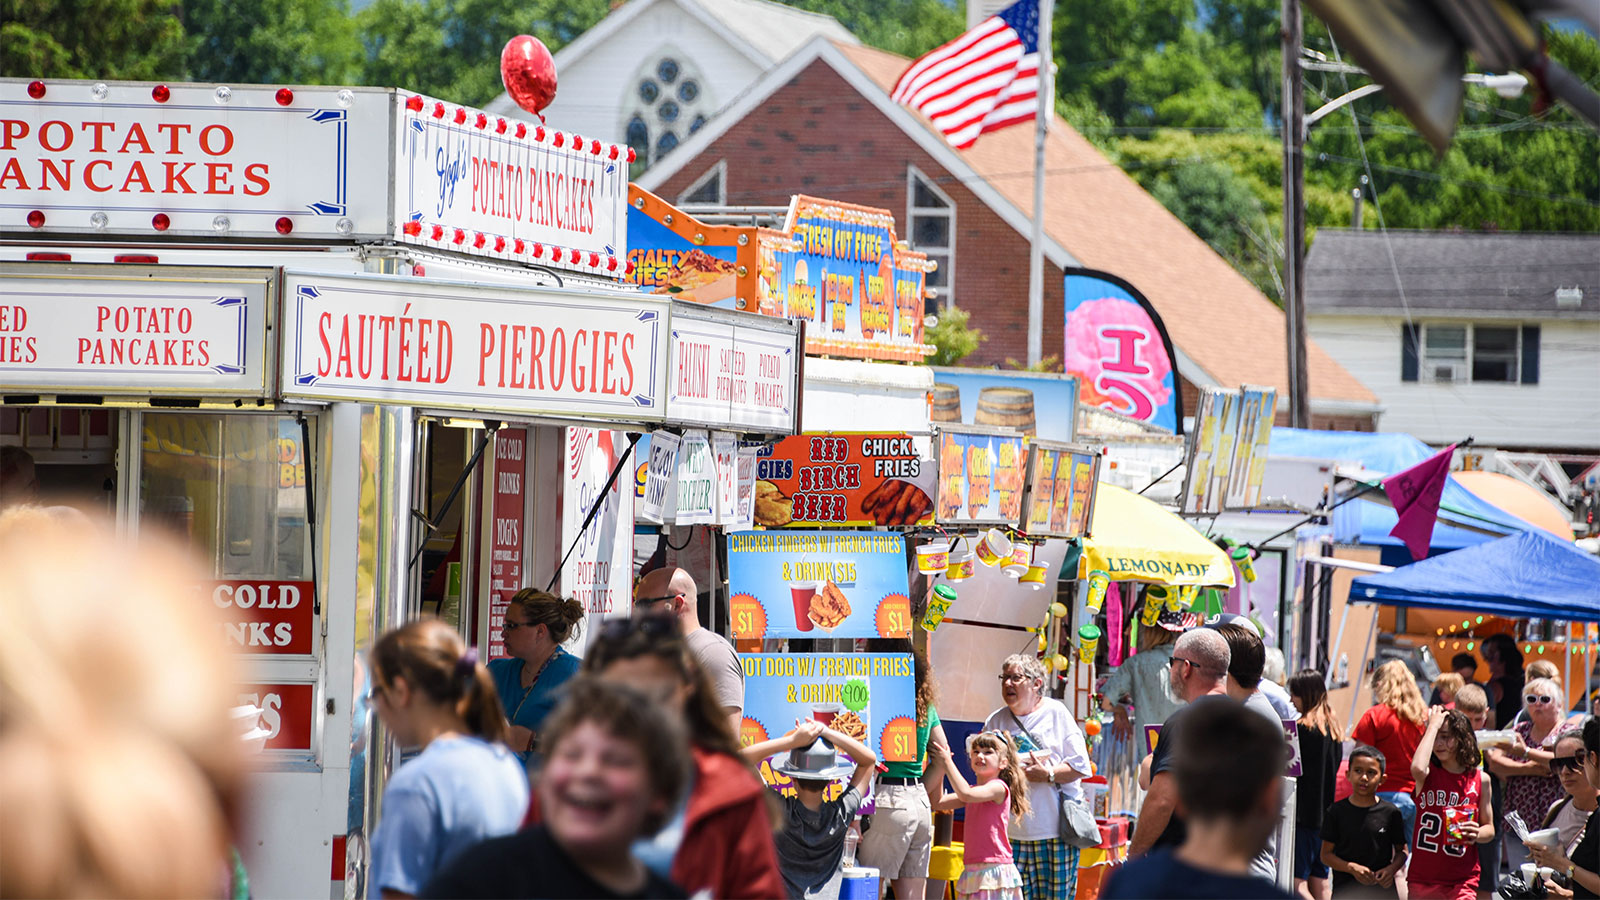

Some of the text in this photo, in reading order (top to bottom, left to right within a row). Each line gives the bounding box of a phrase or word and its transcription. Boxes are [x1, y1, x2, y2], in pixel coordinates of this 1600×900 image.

[0, 119, 235, 156] POTATO
[0, 157, 271, 196] ANCAKES
[471, 156, 523, 221] POTATO
[528, 167, 594, 235] PANCAKES
[802, 222, 833, 258] FRESH
[834, 230, 853, 262] CUT
[96, 306, 193, 334] POTATO
[77, 338, 210, 366] PANCAKES
[317, 303, 636, 397] SAUTÉED PIEROGIES
[677, 341, 711, 399] HALUSKI
[759, 353, 782, 380] POTATO
[716, 376, 748, 404] PIEROGIES
[754, 381, 785, 408] PANCAKES
[497, 437, 523, 461] ICE COLD
[810, 437, 849, 463] RED
[757, 459, 794, 480] GIES
[799, 464, 861, 493] BIRCH
[874, 459, 921, 478] FRIES
[498, 472, 520, 495] DRINKS
[791, 493, 848, 523] BEER
[497, 518, 518, 546] YOGI'S
[732, 535, 901, 554] CHICKEN FINGERS W/ FRENCH FRIES
[577, 561, 609, 585] POTATO
[782, 562, 857, 583] & DRINK $15
[213, 584, 301, 609] COLD
[737, 610, 753, 634] $1
[888, 610, 903, 634] $1
[766, 658, 795, 677] DOG
[797, 658, 816, 678] W/
[819, 658, 871, 677] FRENCH
[873, 658, 911, 677] FRIES
[786, 684, 844, 703] & DRINK
[893, 734, 909, 757] $1
